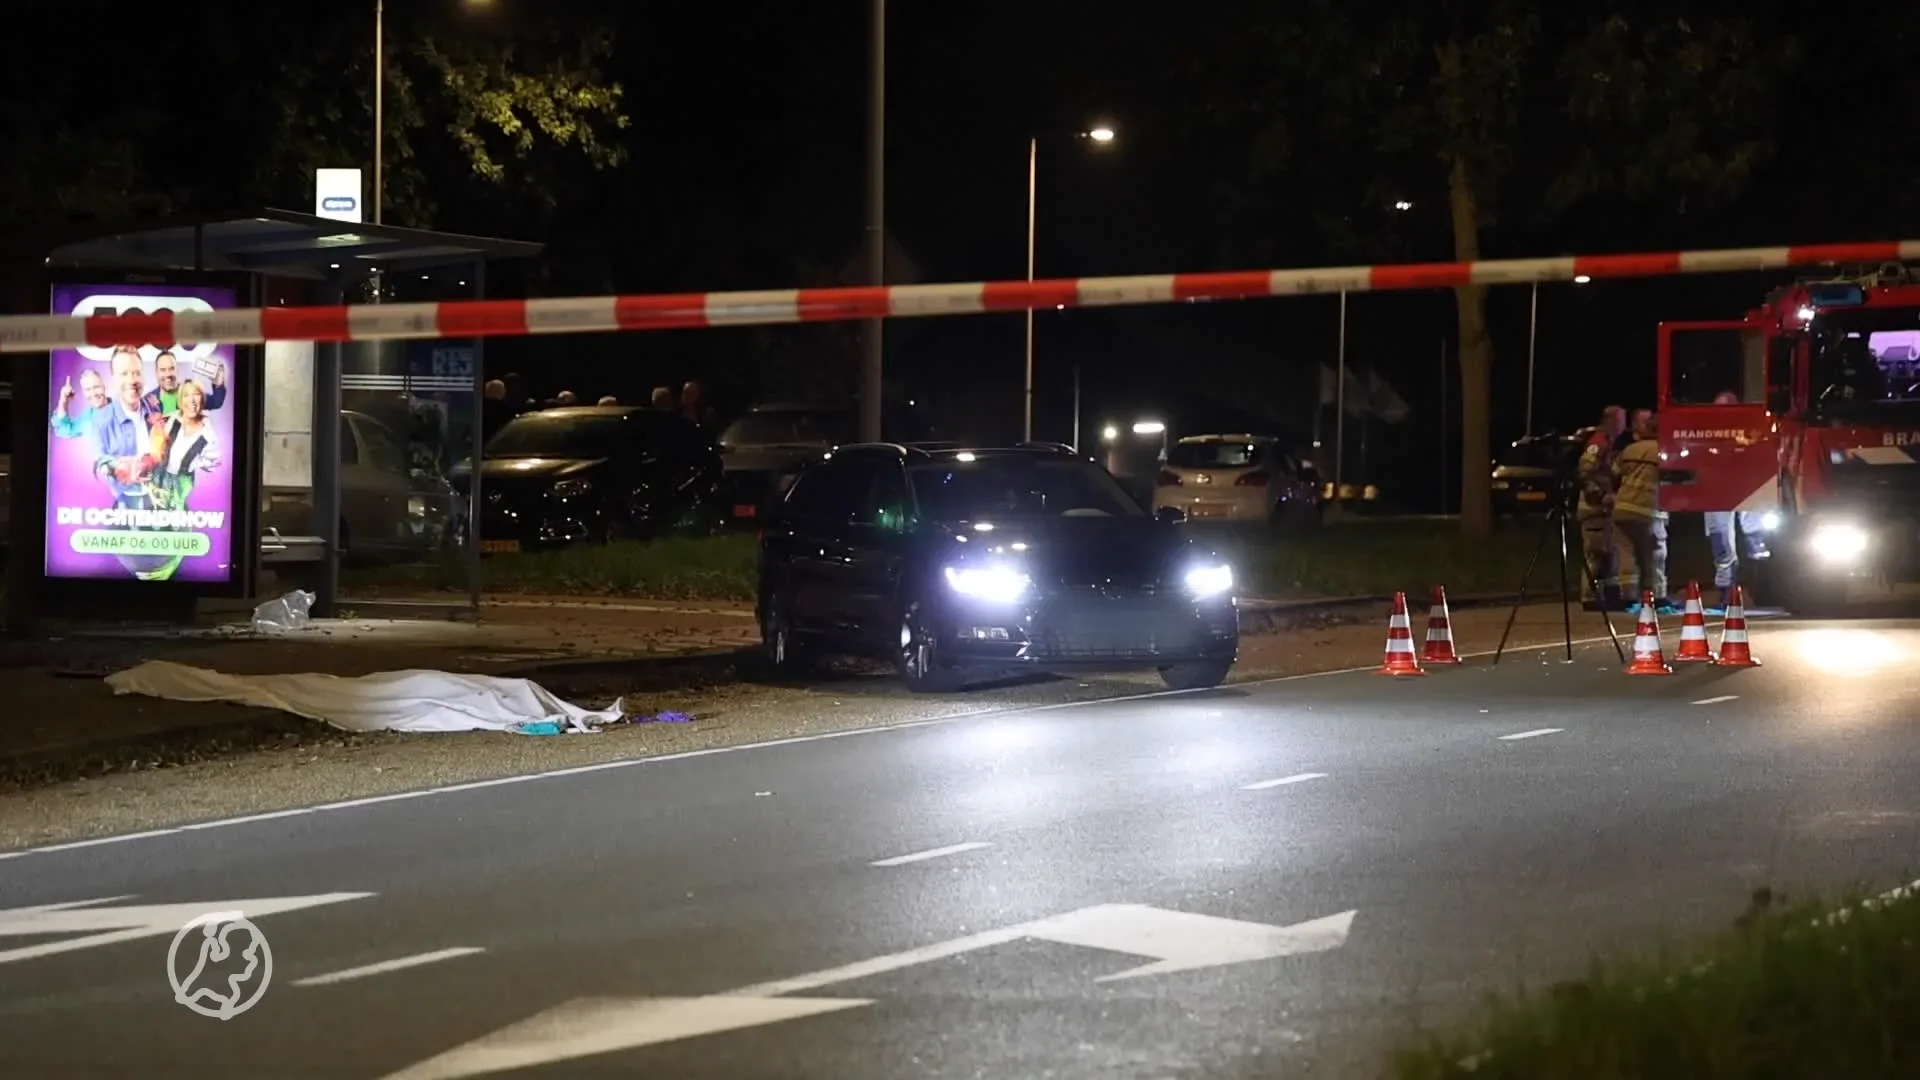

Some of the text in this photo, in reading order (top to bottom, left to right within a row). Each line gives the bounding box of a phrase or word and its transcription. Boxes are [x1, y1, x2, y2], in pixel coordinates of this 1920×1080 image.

[57, 507, 224, 528] DE OCHTENDSHOW
[82, 536, 126, 549] VANAF
[173, 539, 199, 550] UUR
